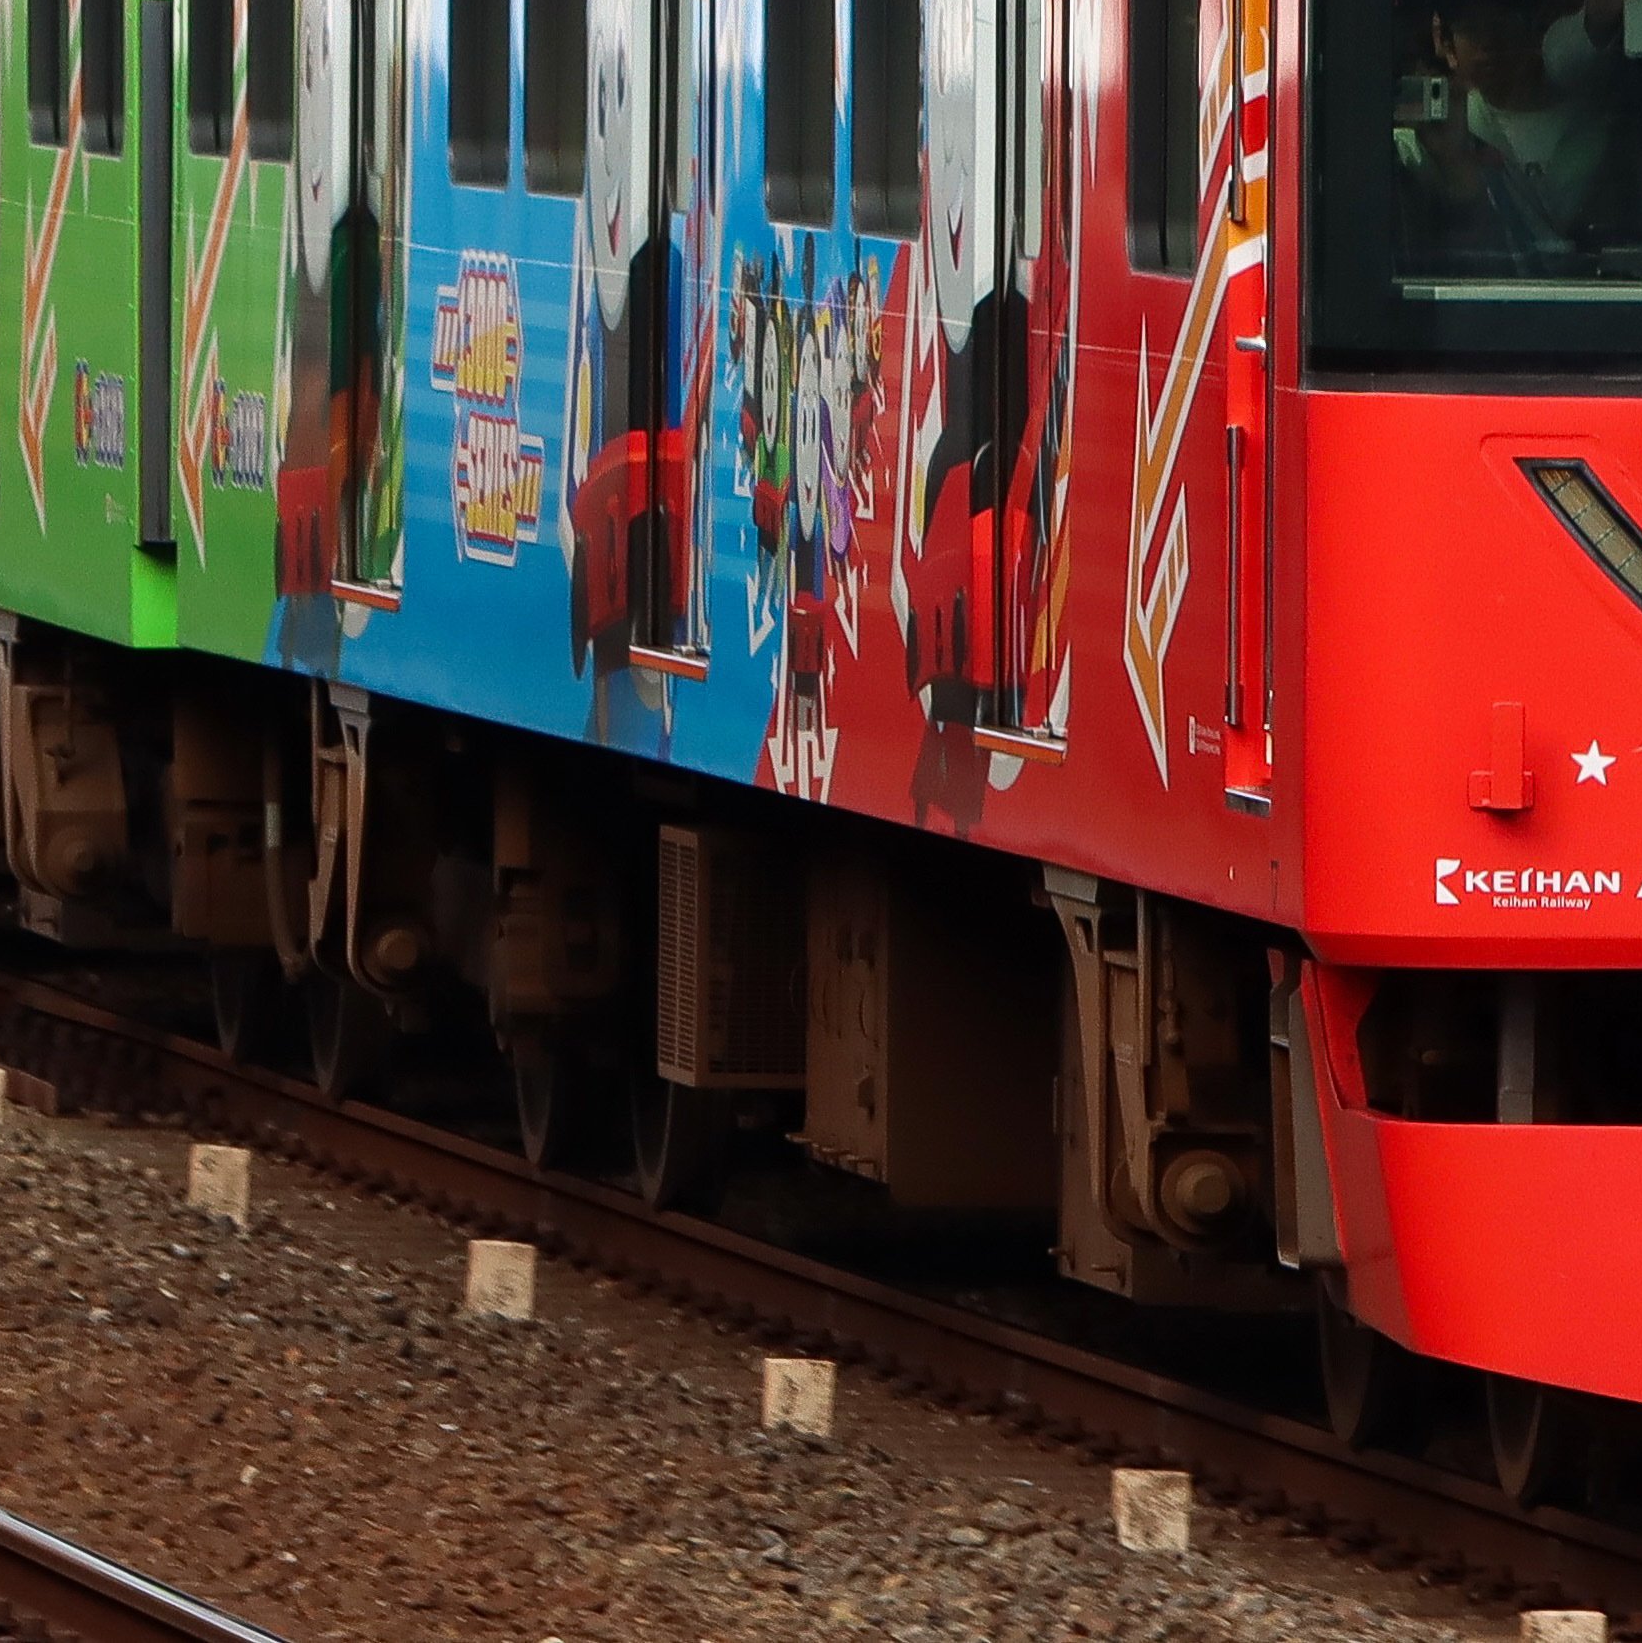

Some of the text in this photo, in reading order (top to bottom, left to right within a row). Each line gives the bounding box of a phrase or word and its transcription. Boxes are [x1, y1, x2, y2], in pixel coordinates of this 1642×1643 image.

[465, 410, 518, 548] SERIES
[1465, 867, 1621, 893] KEIHAN
[1493, 897, 1592, 910] Keihan Railway
